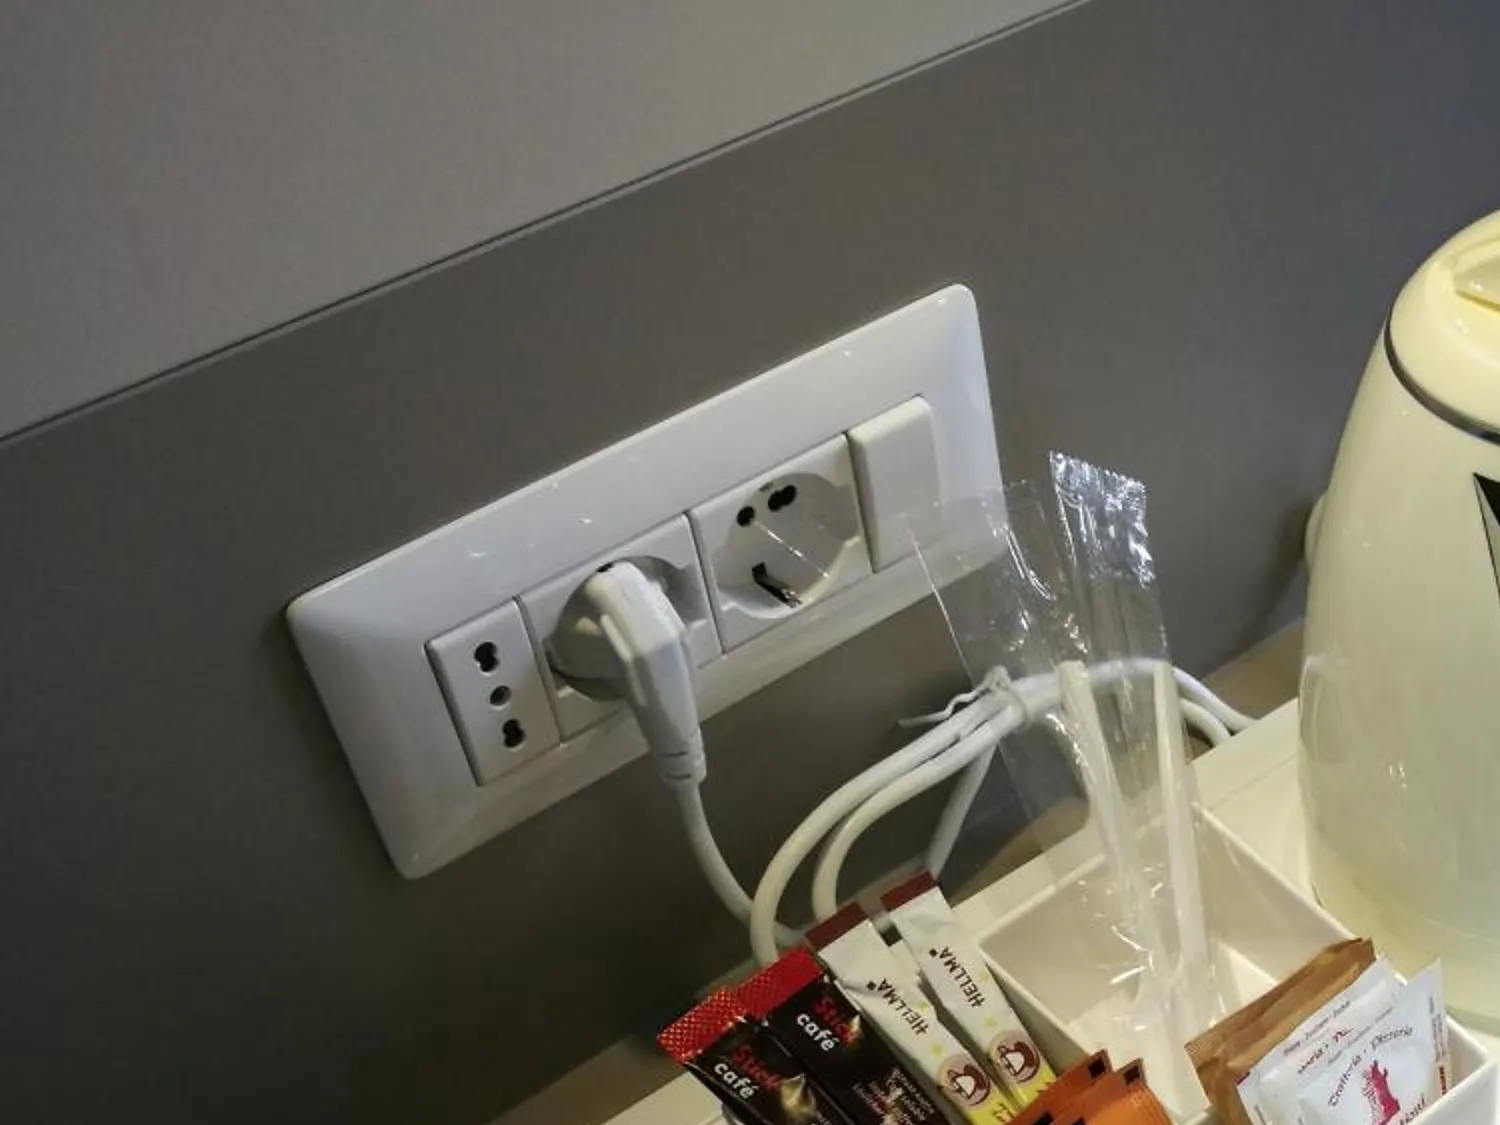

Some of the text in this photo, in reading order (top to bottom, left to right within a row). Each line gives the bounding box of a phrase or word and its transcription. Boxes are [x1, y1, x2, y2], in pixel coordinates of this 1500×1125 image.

[939, 946, 986, 1008] HELLMA
[877, 978, 929, 1035] HELLMA
[797, 1012, 841, 1052] café
[713, 1062, 759, 1099] café
